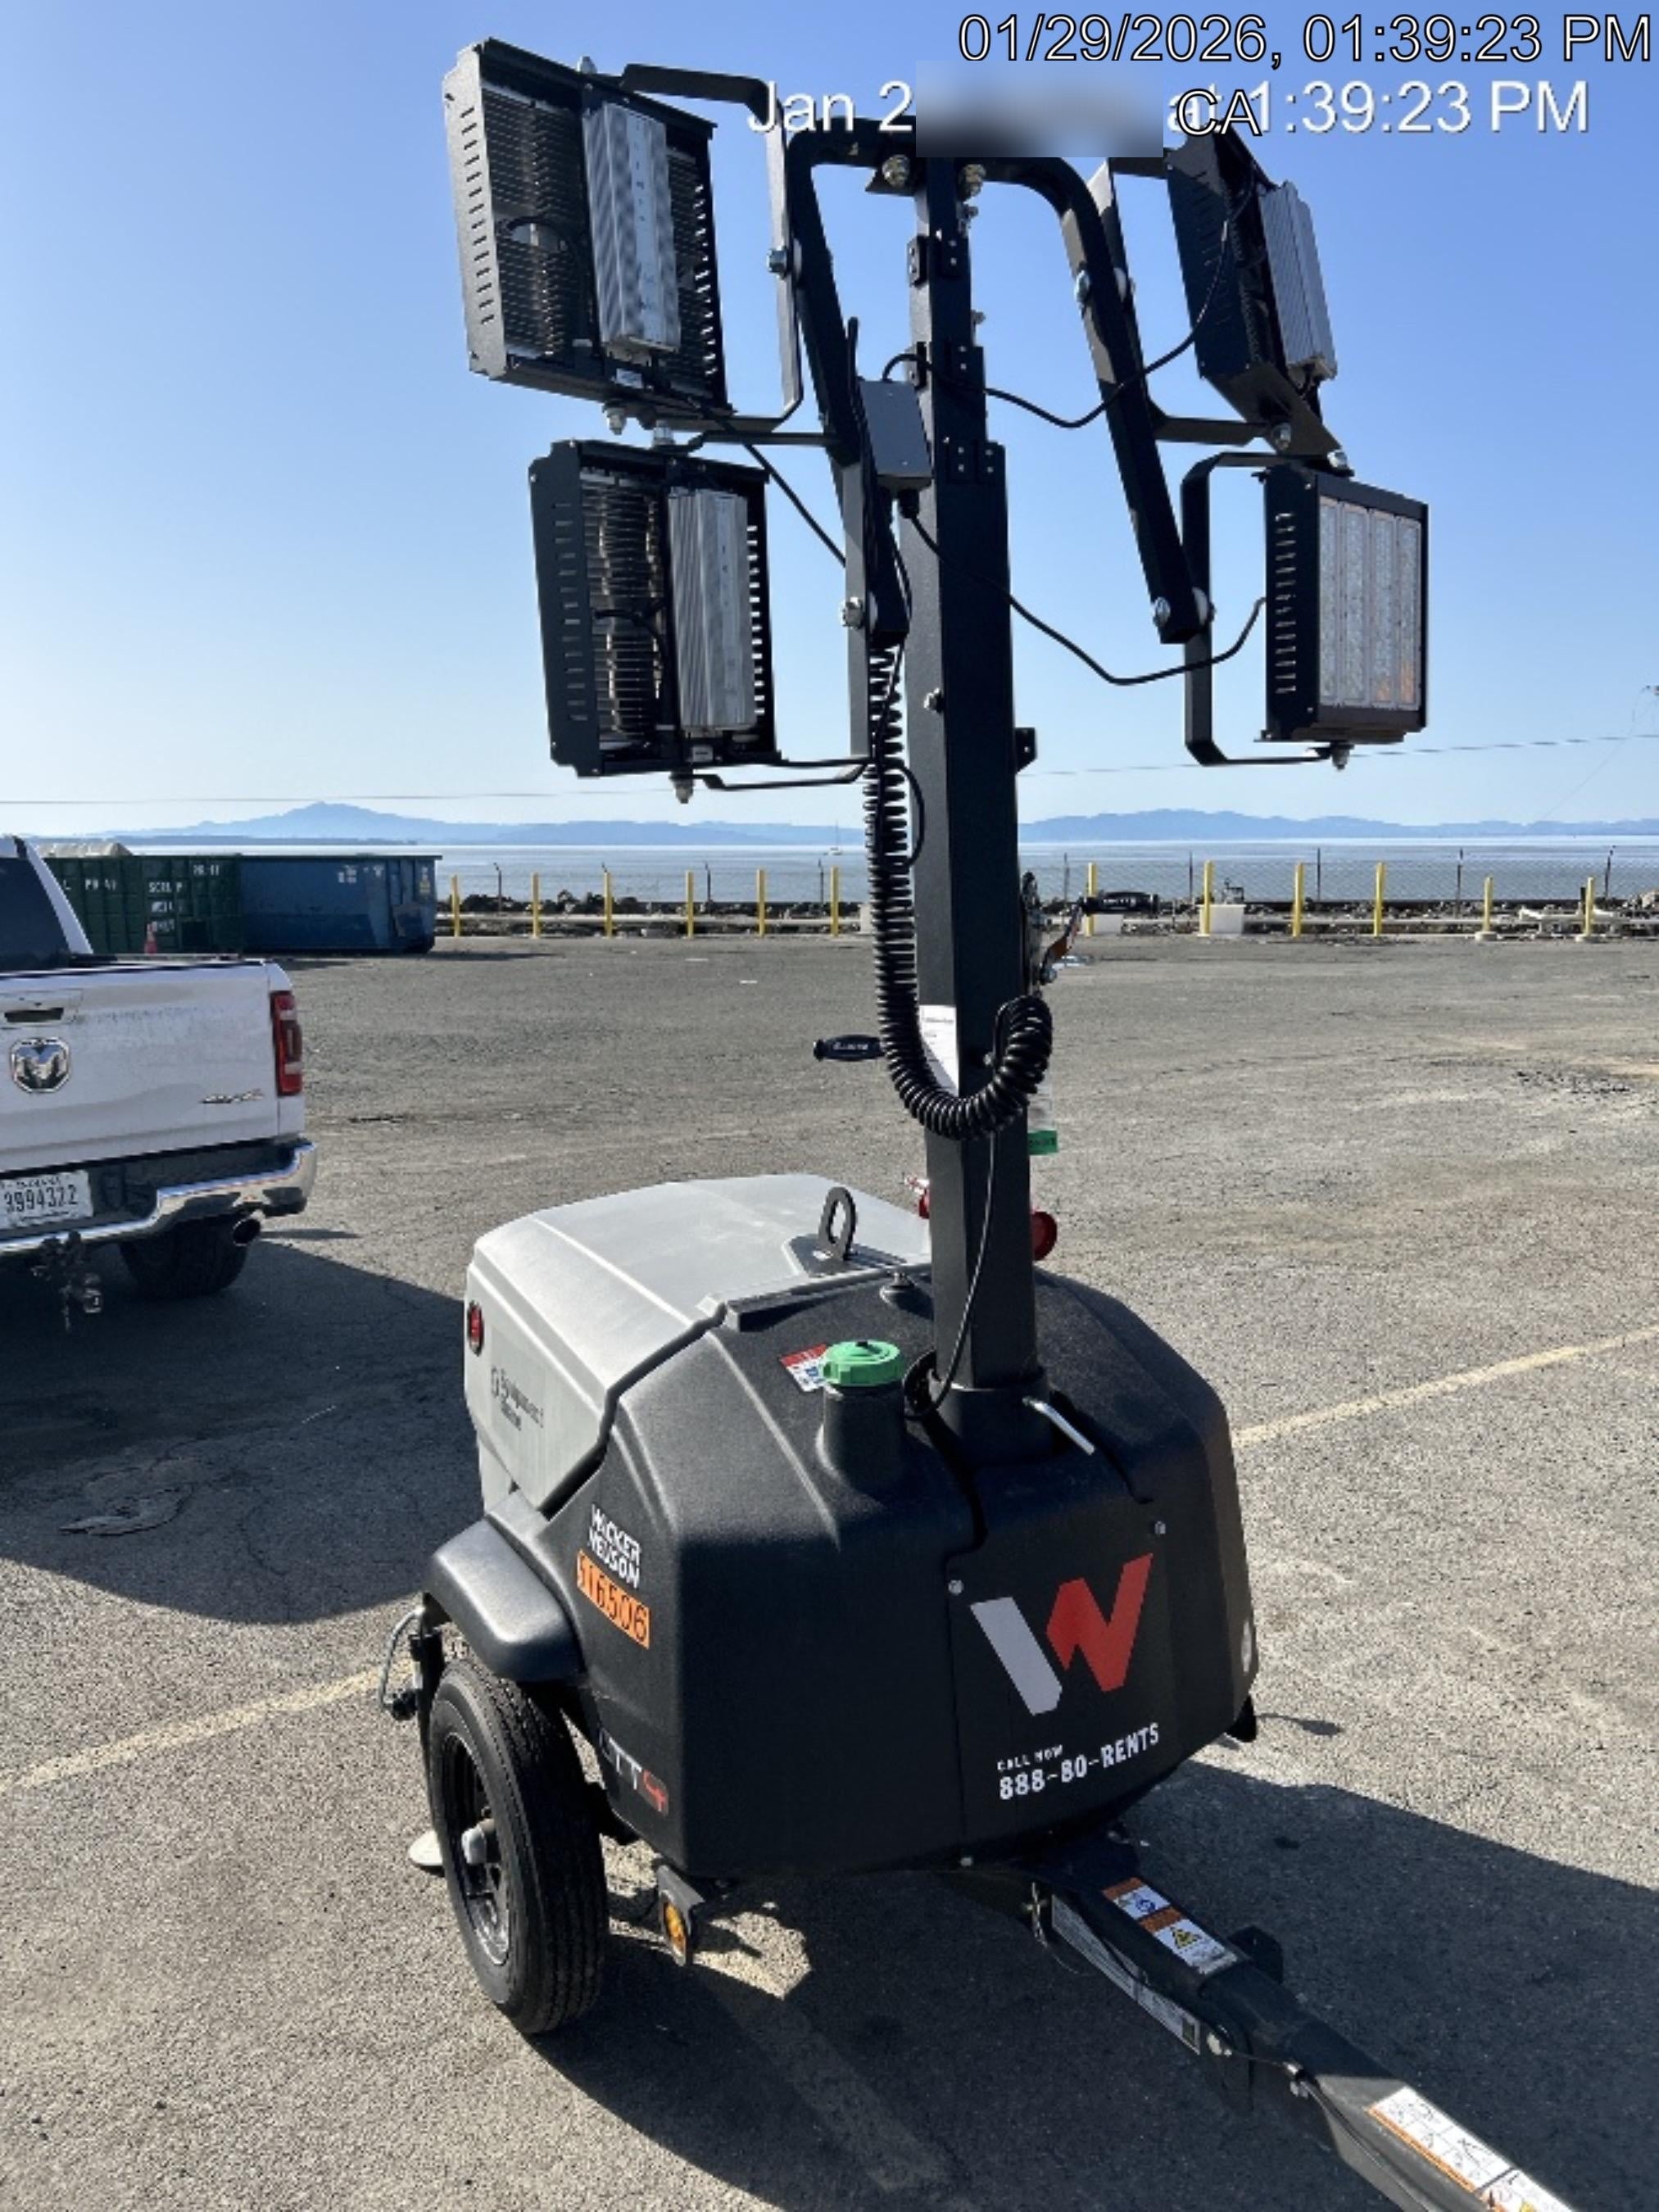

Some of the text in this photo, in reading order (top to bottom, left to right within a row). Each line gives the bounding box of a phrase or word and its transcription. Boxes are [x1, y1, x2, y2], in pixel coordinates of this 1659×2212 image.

[588, 1526, 641, 1589] NEUSON
[591, 1503, 641, 1566] WACKER
[997, 1744, 1063, 1772] CALL NOW
